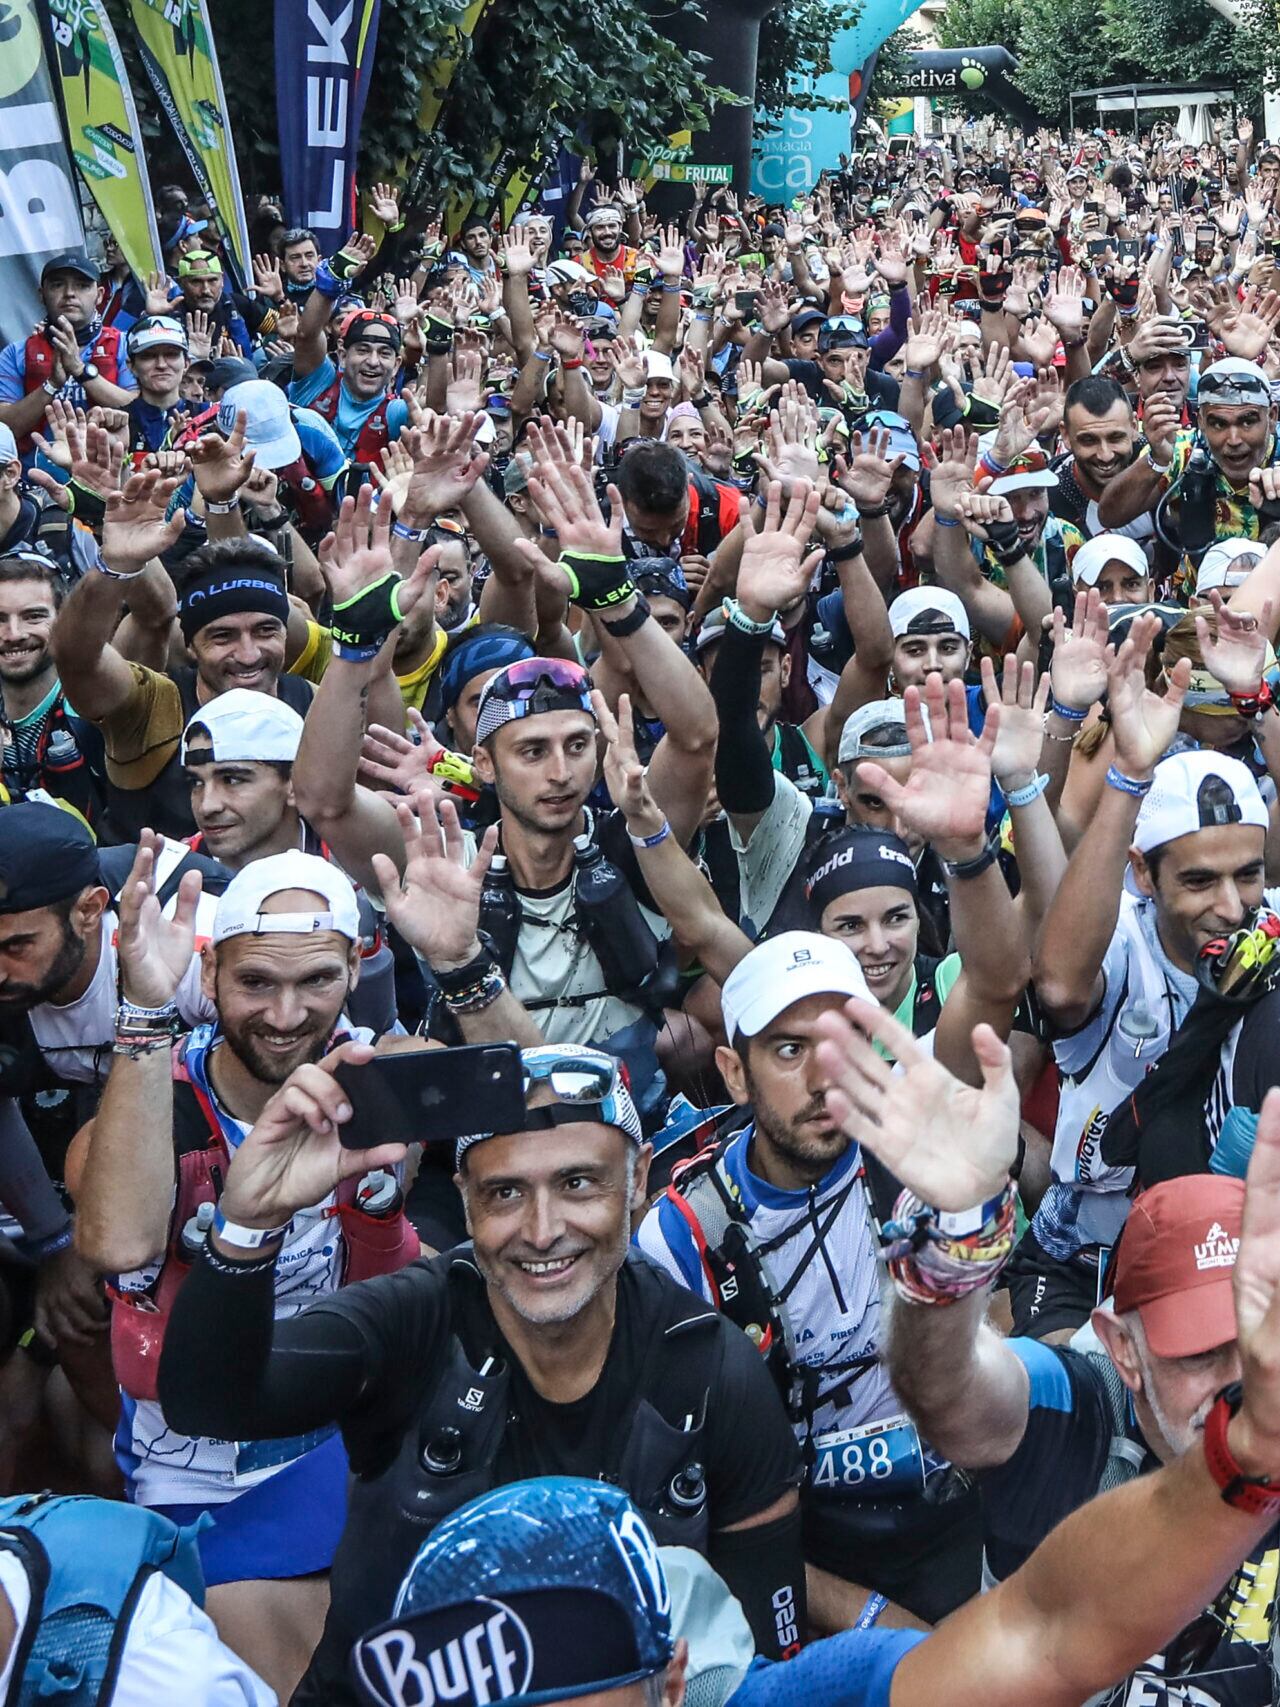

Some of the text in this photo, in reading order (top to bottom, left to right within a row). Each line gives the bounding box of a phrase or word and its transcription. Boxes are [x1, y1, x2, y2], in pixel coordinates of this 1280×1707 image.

[209, 579, 283, 597] LURBEL
[594, 580, 633, 606] LEKI
[332, 626, 361, 644] EKI
[806, 847, 854, 886] world
[814, 1437, 895, 1488] 488
